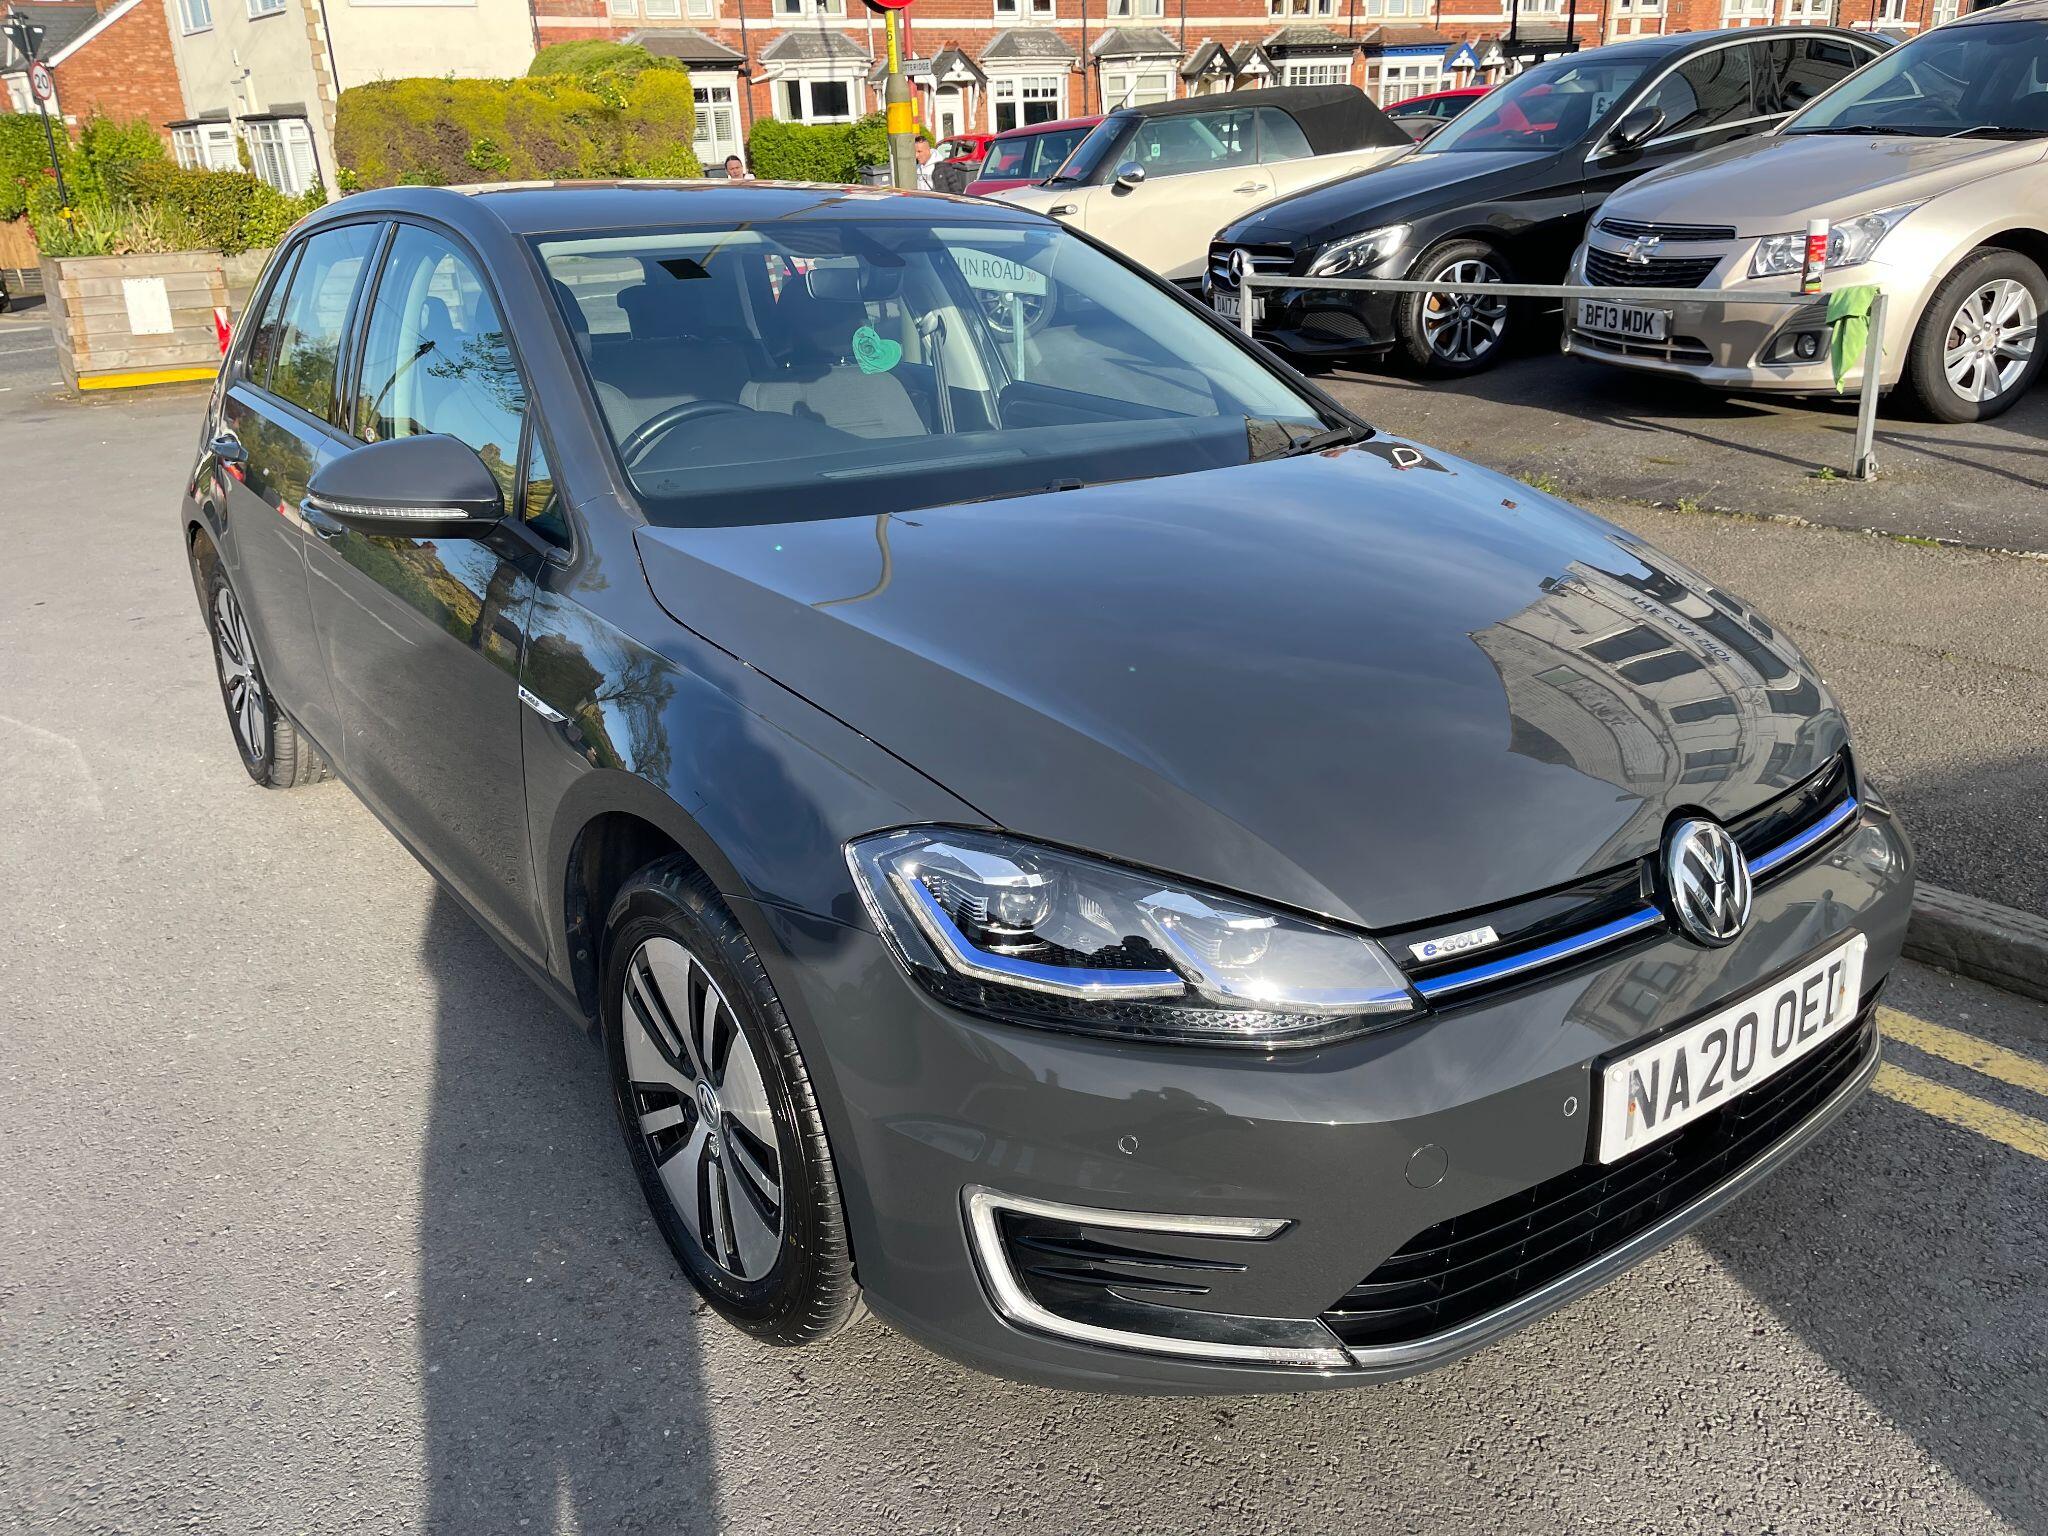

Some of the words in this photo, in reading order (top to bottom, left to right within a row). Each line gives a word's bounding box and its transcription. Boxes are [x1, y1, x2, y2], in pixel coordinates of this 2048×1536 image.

[34, 73, 48, 89] 20
[982, 260, 1024, 280] ROAD
[1585, 304, 1617, 329] BF13
[1622, 309, 1655, 334] MDK
[1625, 1012, 1758, 1140] NA20
